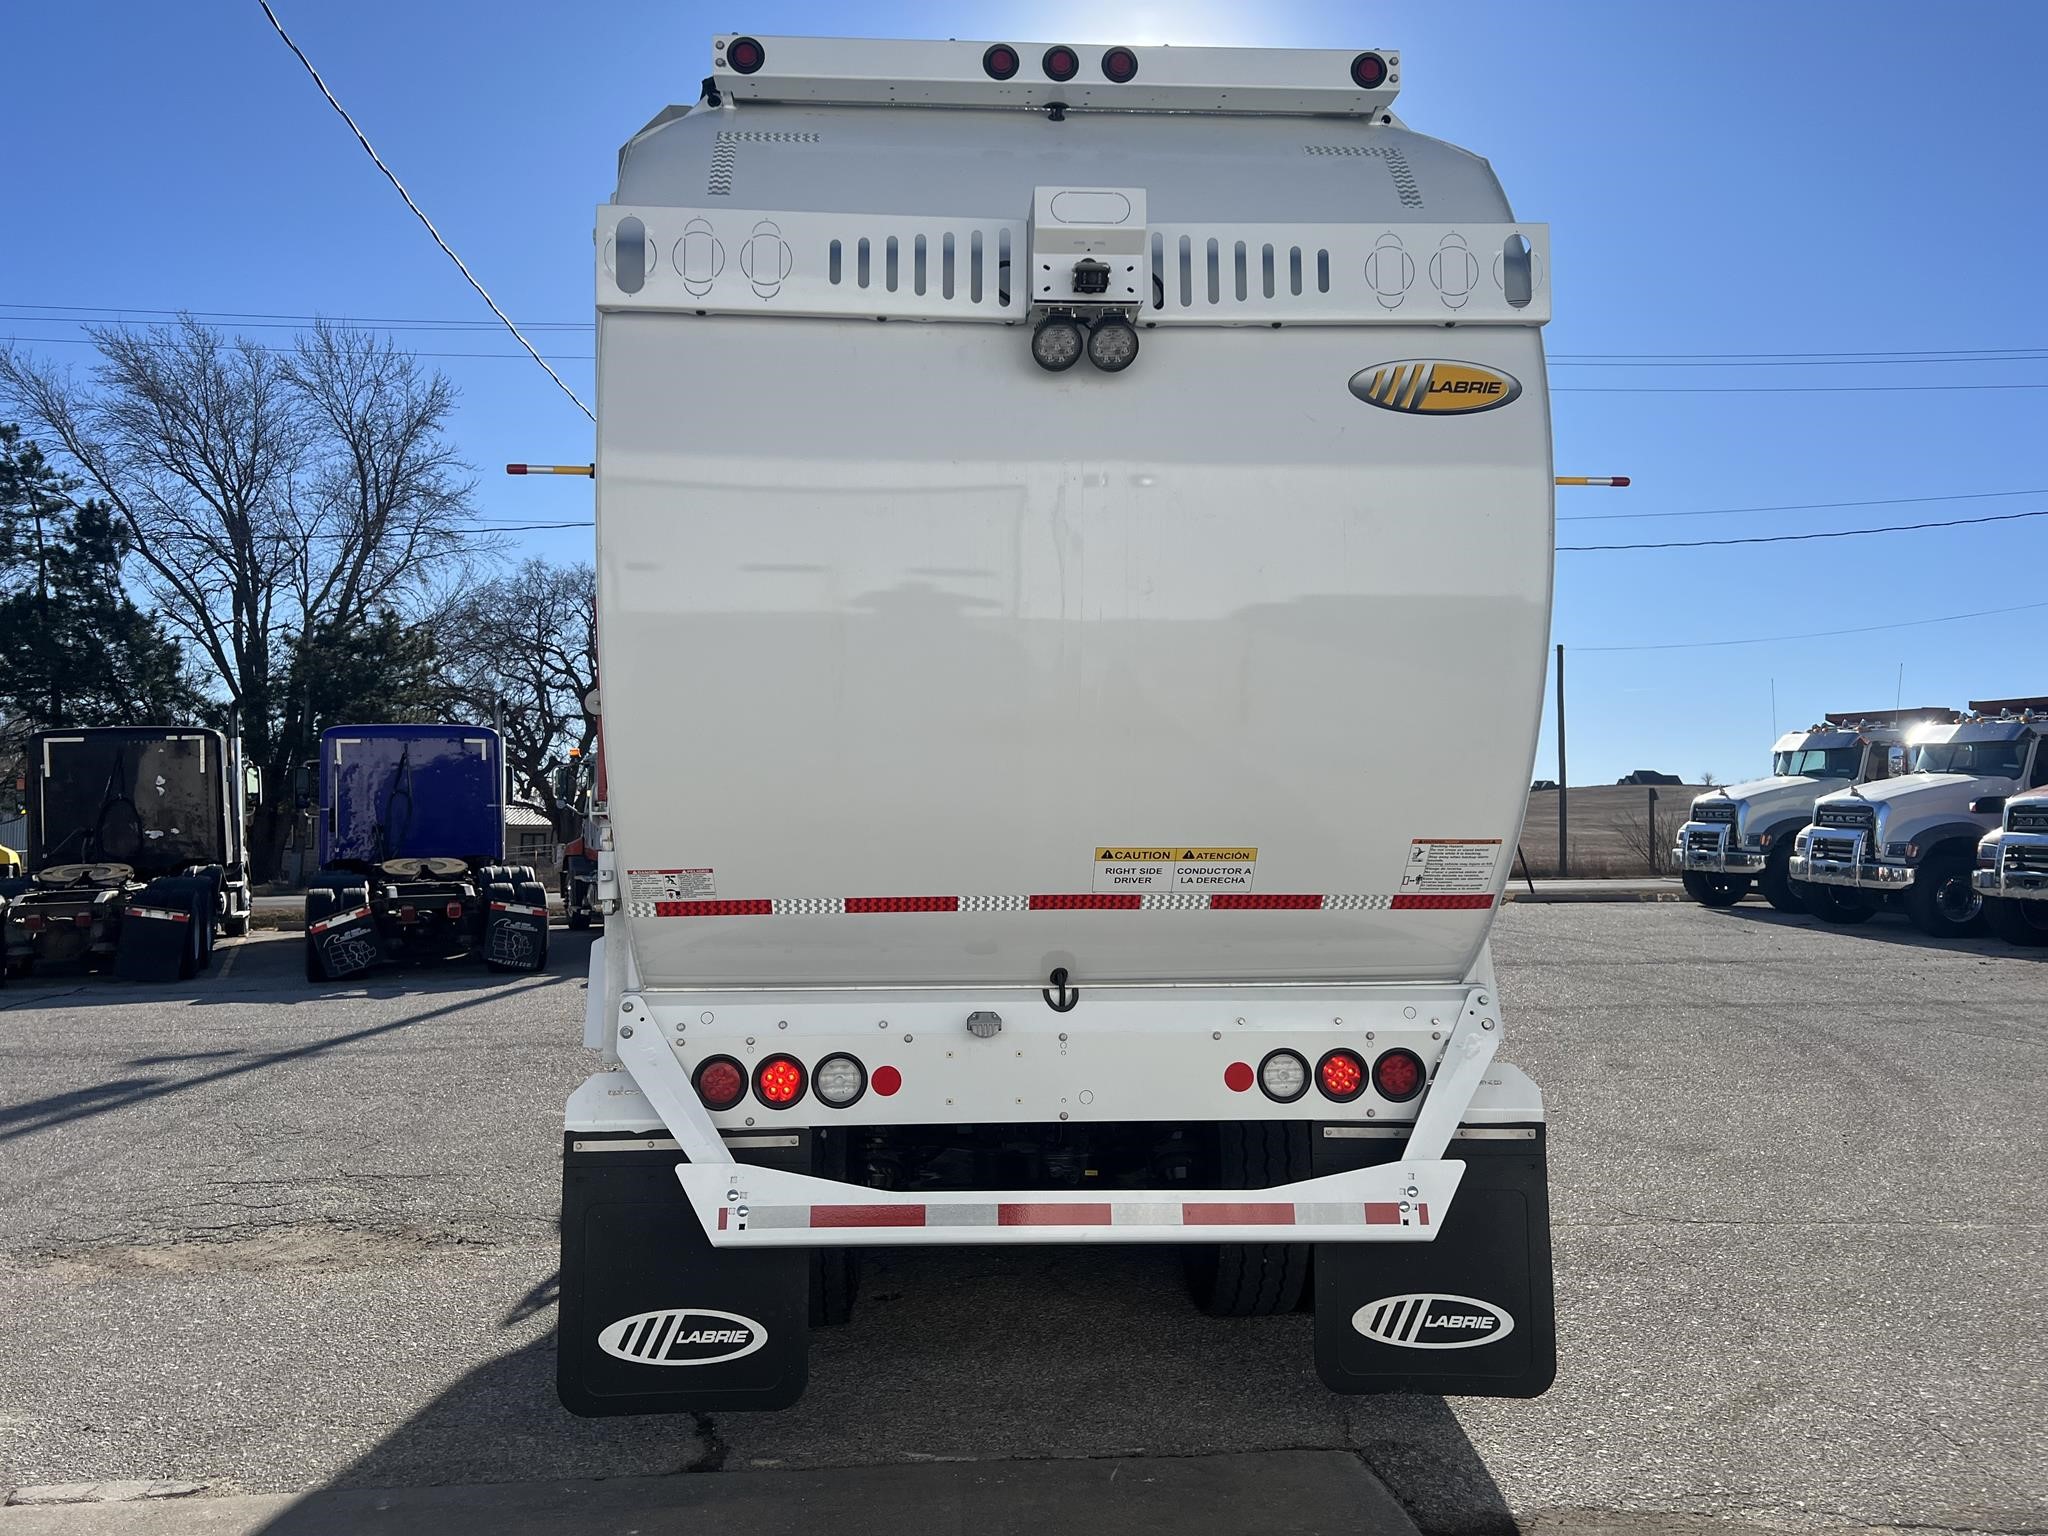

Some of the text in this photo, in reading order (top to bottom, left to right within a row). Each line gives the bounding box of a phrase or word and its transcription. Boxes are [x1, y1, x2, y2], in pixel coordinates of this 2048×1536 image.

[1428, 381, 1503, 394] LABRIE
[1822, 815, 1868, 823] MACK
[1114, 851, 1171, 860] CAUTION
[1196, 851, 1250, 860] ATENCIÓN
[1105, 867, 1163, 875] RIGHT SIDE
[1177, 867, 1252, 875] CONDUCTOR A
[1425, 1315, 1495, 1329] LABRIE
[676, 1330, 749, 1343] LABRIE
